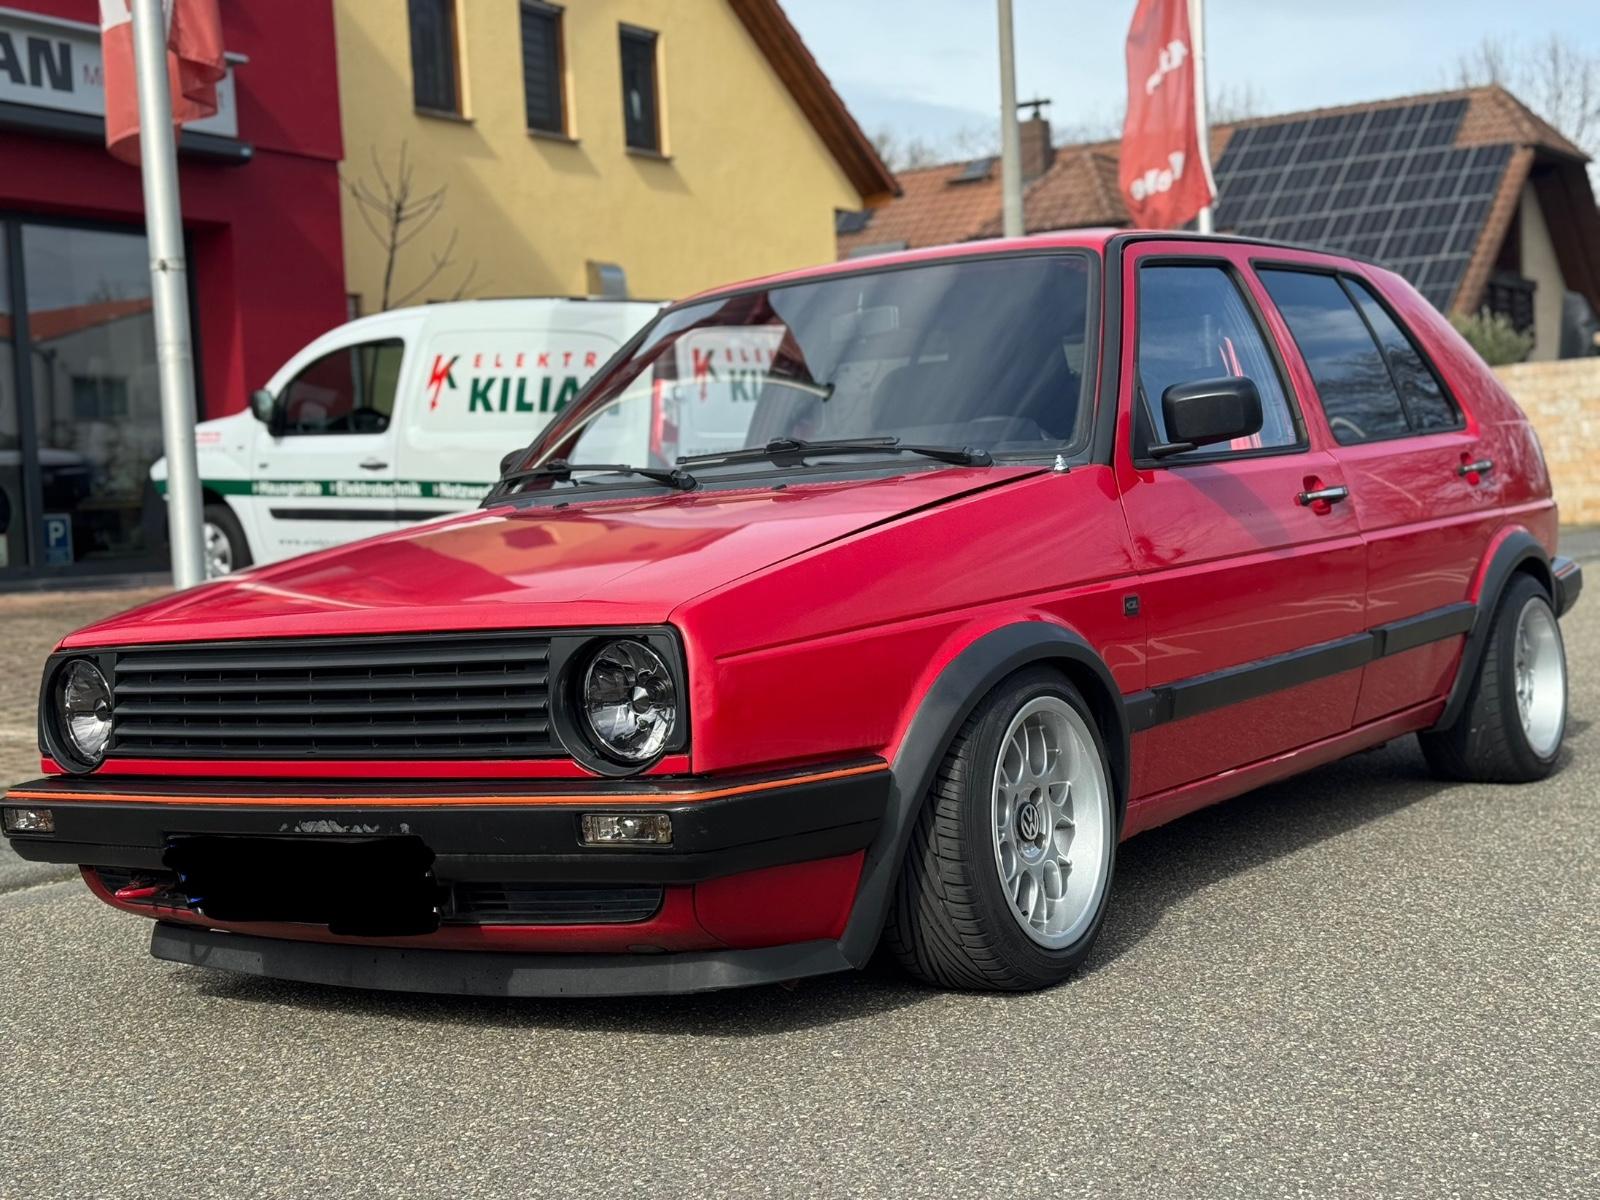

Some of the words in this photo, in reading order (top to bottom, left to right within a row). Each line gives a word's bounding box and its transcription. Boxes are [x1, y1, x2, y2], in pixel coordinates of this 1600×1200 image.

[473, 352, 597, 368] ELEKTR
[468, 376, 581, 413] KILIA
[47, 520, 66, 547] P
